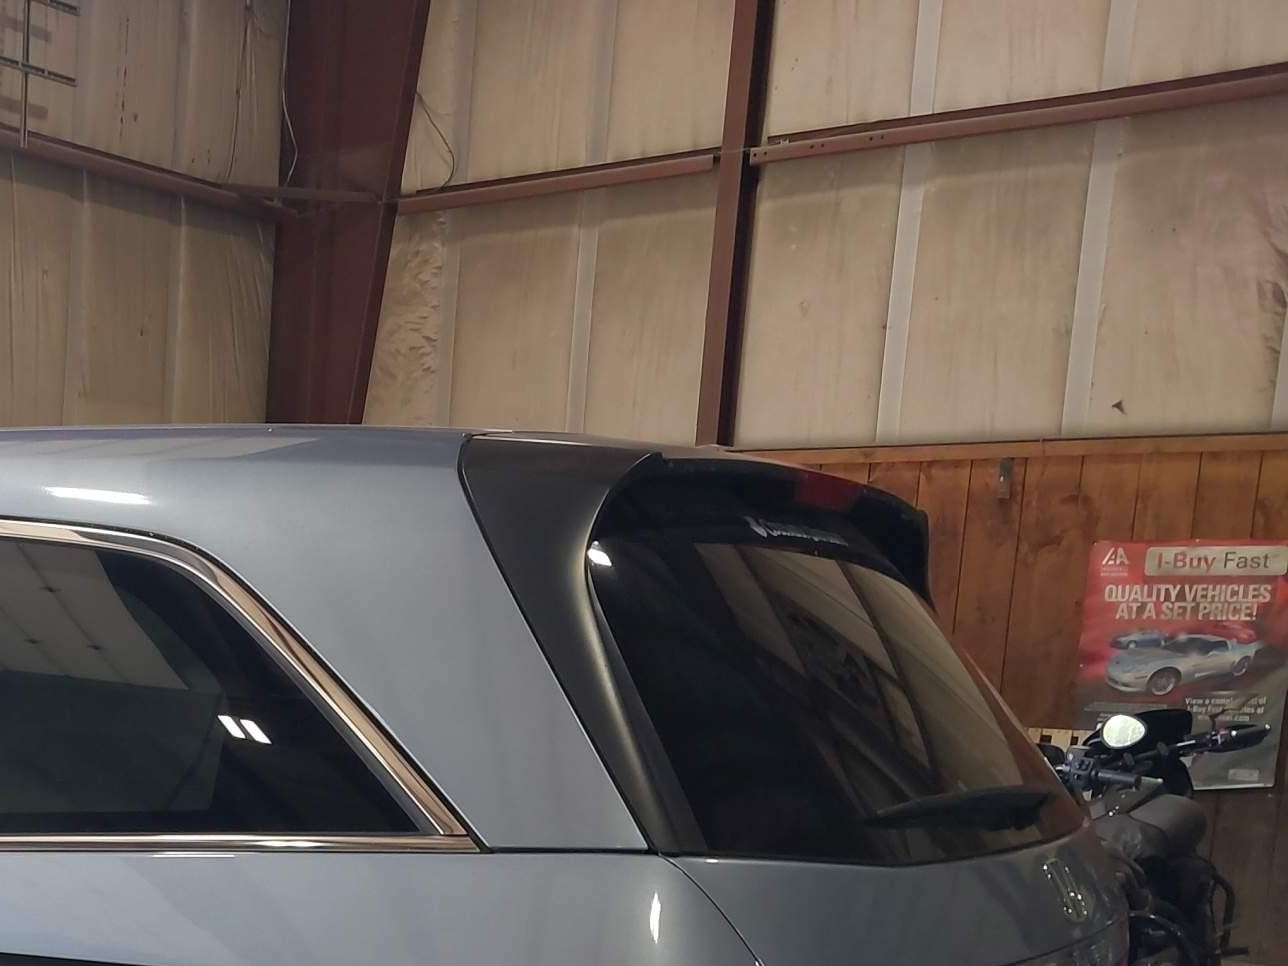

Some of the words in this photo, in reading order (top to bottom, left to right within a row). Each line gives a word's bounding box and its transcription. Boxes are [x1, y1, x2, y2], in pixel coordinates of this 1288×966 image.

[1157, 551, 1215, 573] I-Buy
[1223, 551, 1270, 569] Fast
[1104, 584, 1181, 602] QUALITY
[1184, 584, 1272, 603] VEHICLES
[1115, 603, 1141, 620] AT
[1143, 603, 1156, 619] A
[1161, 602, 1194, 620] SET
[1198, 602, 1258, 621] PRICE!
